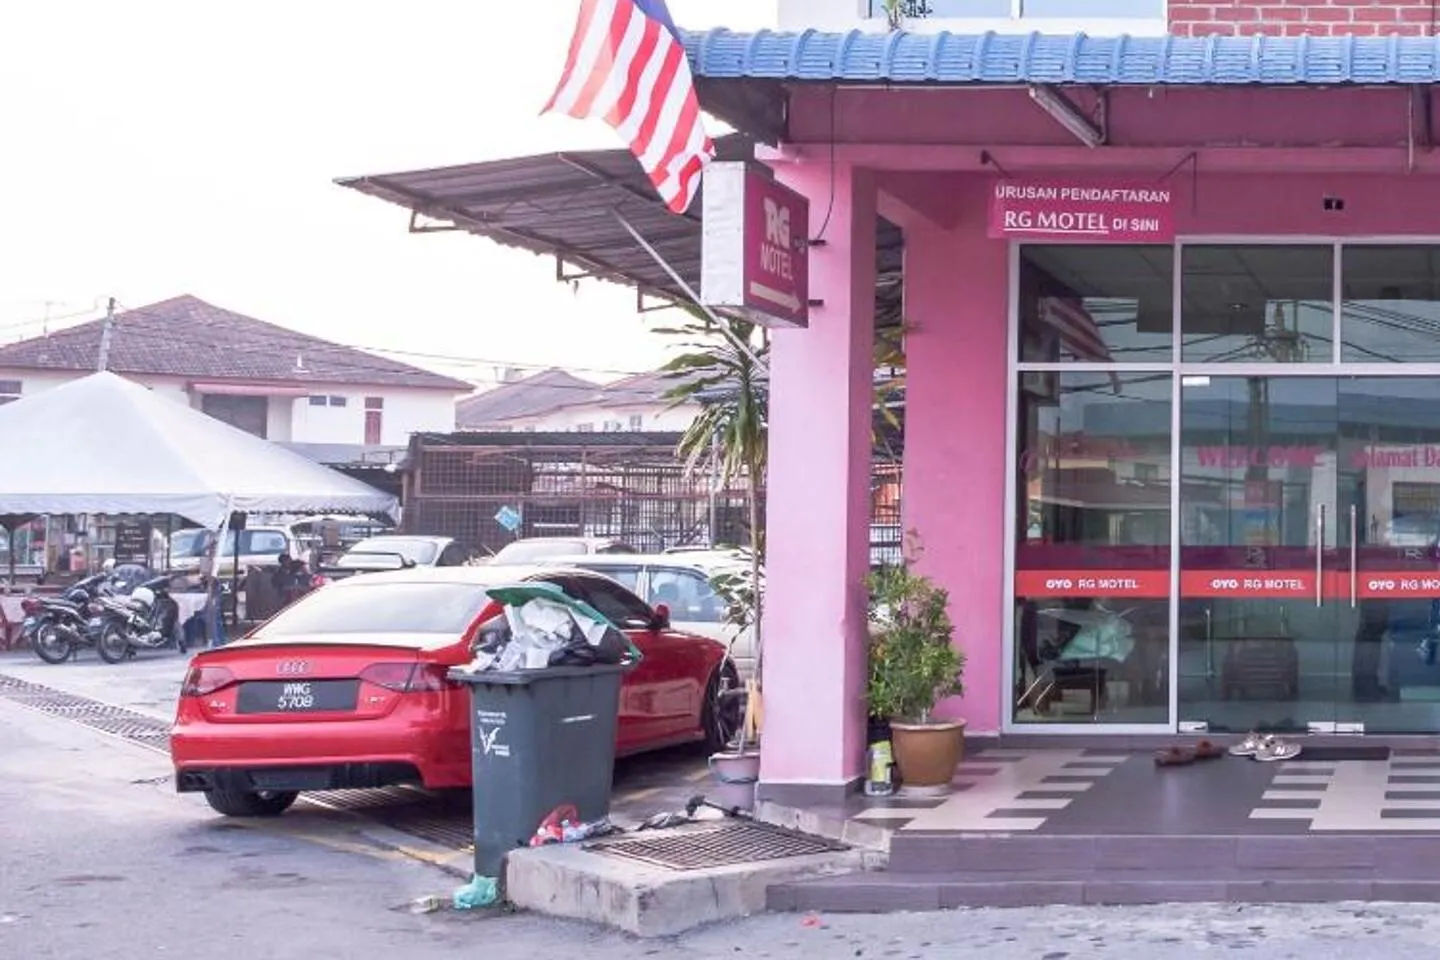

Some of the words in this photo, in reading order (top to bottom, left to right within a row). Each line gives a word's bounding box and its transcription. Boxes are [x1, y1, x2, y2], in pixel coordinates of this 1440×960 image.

[994, 185, 1057, 200] URUSAN
[1060, 187, 1170, 203] PENDAFTARAN
[1004, 210, 1032, 228] RG
[1037, 211, 1109, 230] MOTEL
[1112, 218, 1127, 229] DI
[1130, 218, 1160, 232] SINI
[1099, 579, 1139, 589] MOTEL
[1265, 579, 1305, 590] MOTEL
